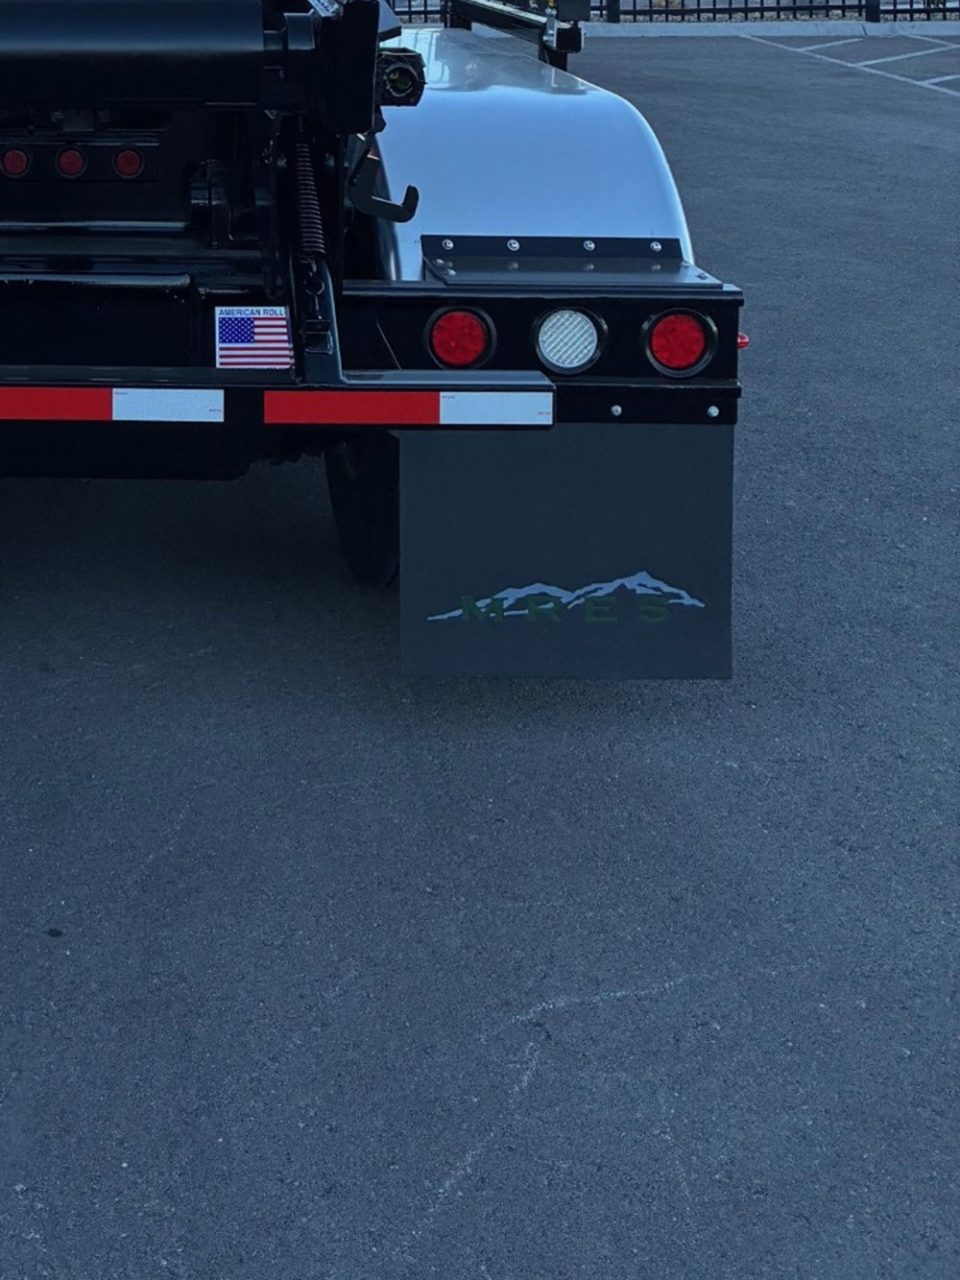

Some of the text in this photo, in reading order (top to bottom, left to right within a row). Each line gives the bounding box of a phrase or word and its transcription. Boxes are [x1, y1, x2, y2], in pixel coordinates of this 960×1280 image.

[218, 308, 284, 316] AMERICAN ROLL
[460, 595, 671, 624] MRES
